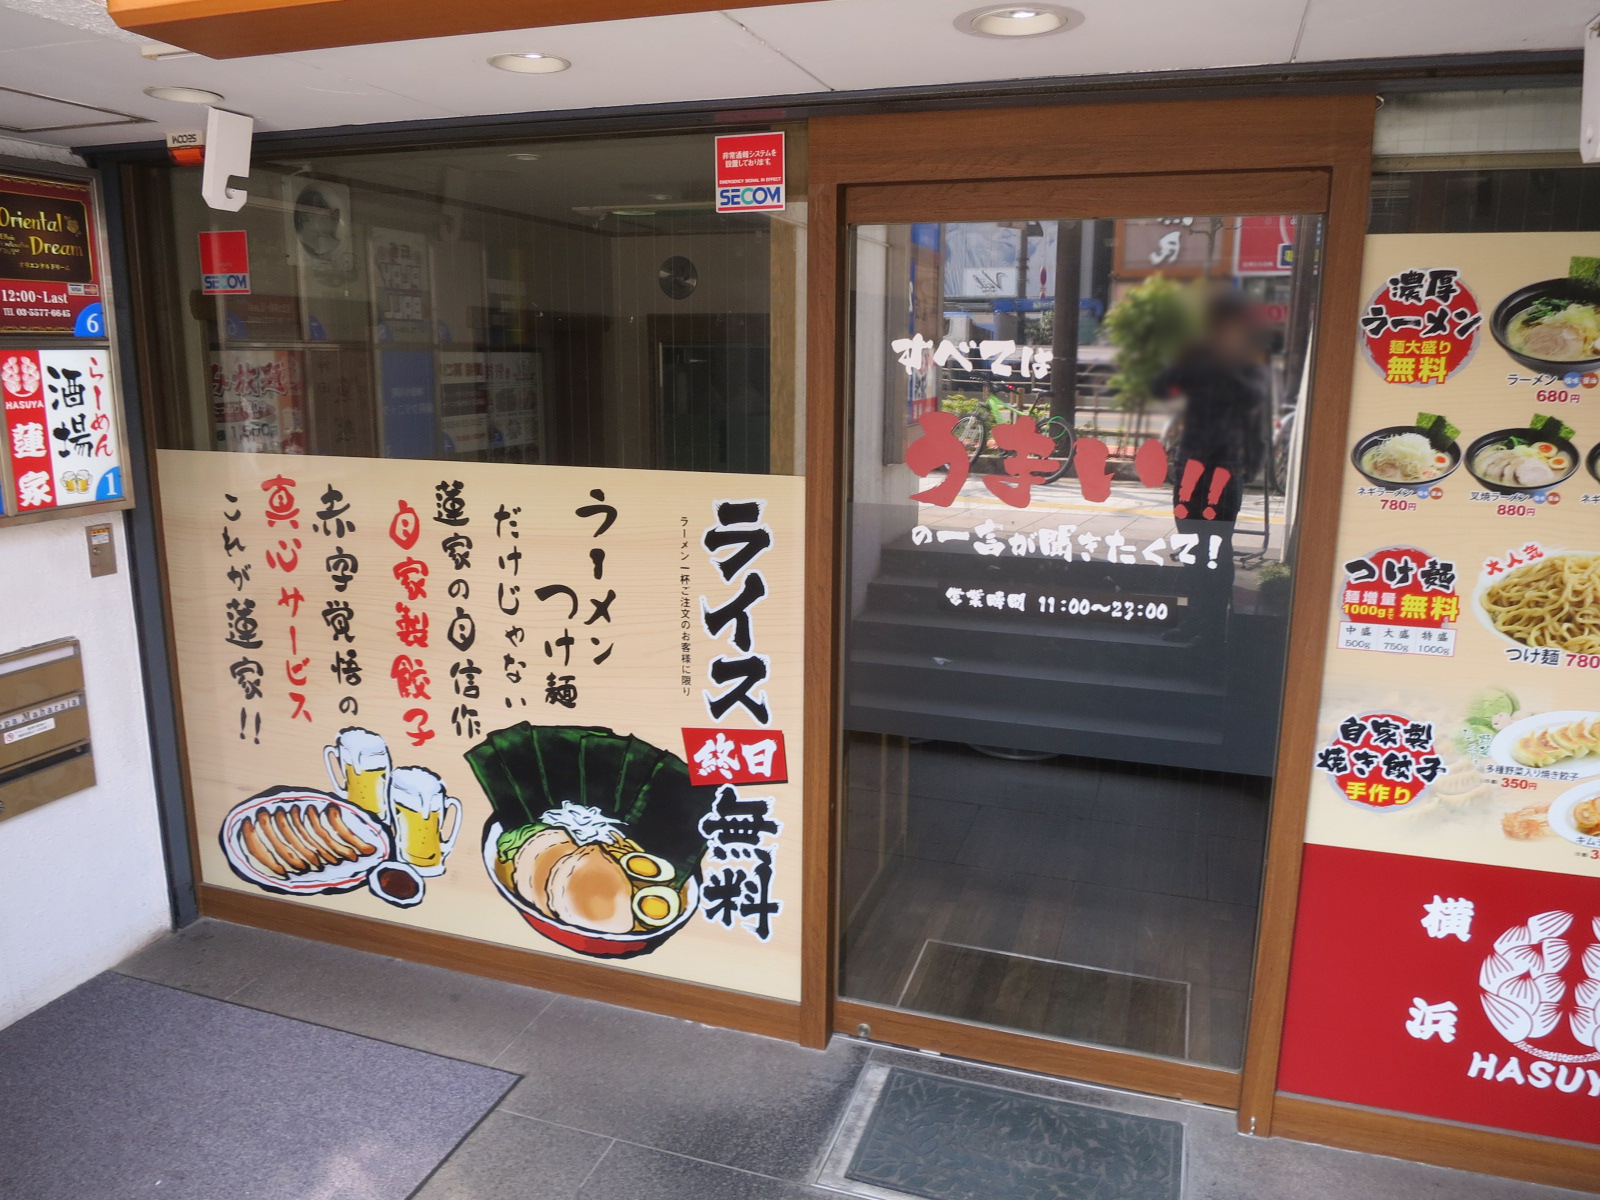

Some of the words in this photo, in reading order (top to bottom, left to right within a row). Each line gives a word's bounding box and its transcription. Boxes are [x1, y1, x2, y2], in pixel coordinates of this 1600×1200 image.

[720, 187, 781, 206] SECOM
[0, 207, 63, 232] Oriental
[29, 236, 84, 256] Dream
[204, 275, 247, 289] SECOM
[1388, 269, 1462, 304] 濃厚
[87, 313, 99, 333] 6
[1360, 306, 1484, 338] ラーメン
[892, 333, 1054, 379] すべては
[1389, 340, 1453, 355] 麺大盛り
[1386, 356, 1448, 384] 無料
[1507, 373, 1559, 386] ラーメン
[6, 400, 45, 410] HASUYA
[47, 366, 93, 458] 酒場
[89, 357, 113, 457] らーめん
[12, 422, 53, 507] 蓮家
[106, 473, 118, 495] 1
[1380, 500, 1416, 511] 780円
[1497, 505, 1536, 516] 880円
[1485, 543, 1545, 576] 大人気
[1345, 558, 1457, 590] つけ麺
[261, 474, 312, 722] 真心サービス
[312, 484, 362, 715] 赤字覚悟の
[433, 480, 482, 738] 蓮家の自信作
[494, 504, 527, 708] だけじゃない
[945, 587, 1027, 612] 営業時間
[1345, 590, 1396, 605] 麺増量
[1400, 594, 1459, 621] 無料
[389, 500, 435, 746] 自家製餃子
[701, 499, 773, 725] ライス
[535, 584, 578, 709] つけ麺
[1345, 640, 1371, 649] 500g
[1384, 642, 1409, 652] 750g
[1419, 644, 1450, 655] 1000g
[1506, 648, 1560, 666] つけ麺
[1340, 716, 1434, 751] 自家製
[693, 733, 778, 780] 終日
[1317, 746, 1447, 783] 焼き餃子
[1486, 764, 1579, 781] 多種野菜入り焼き餃子
[1501, 777, 1537, 790] 350円
[1346, 782, 1411, 804] 手作り
[700, 785, 783, 942] 無料
